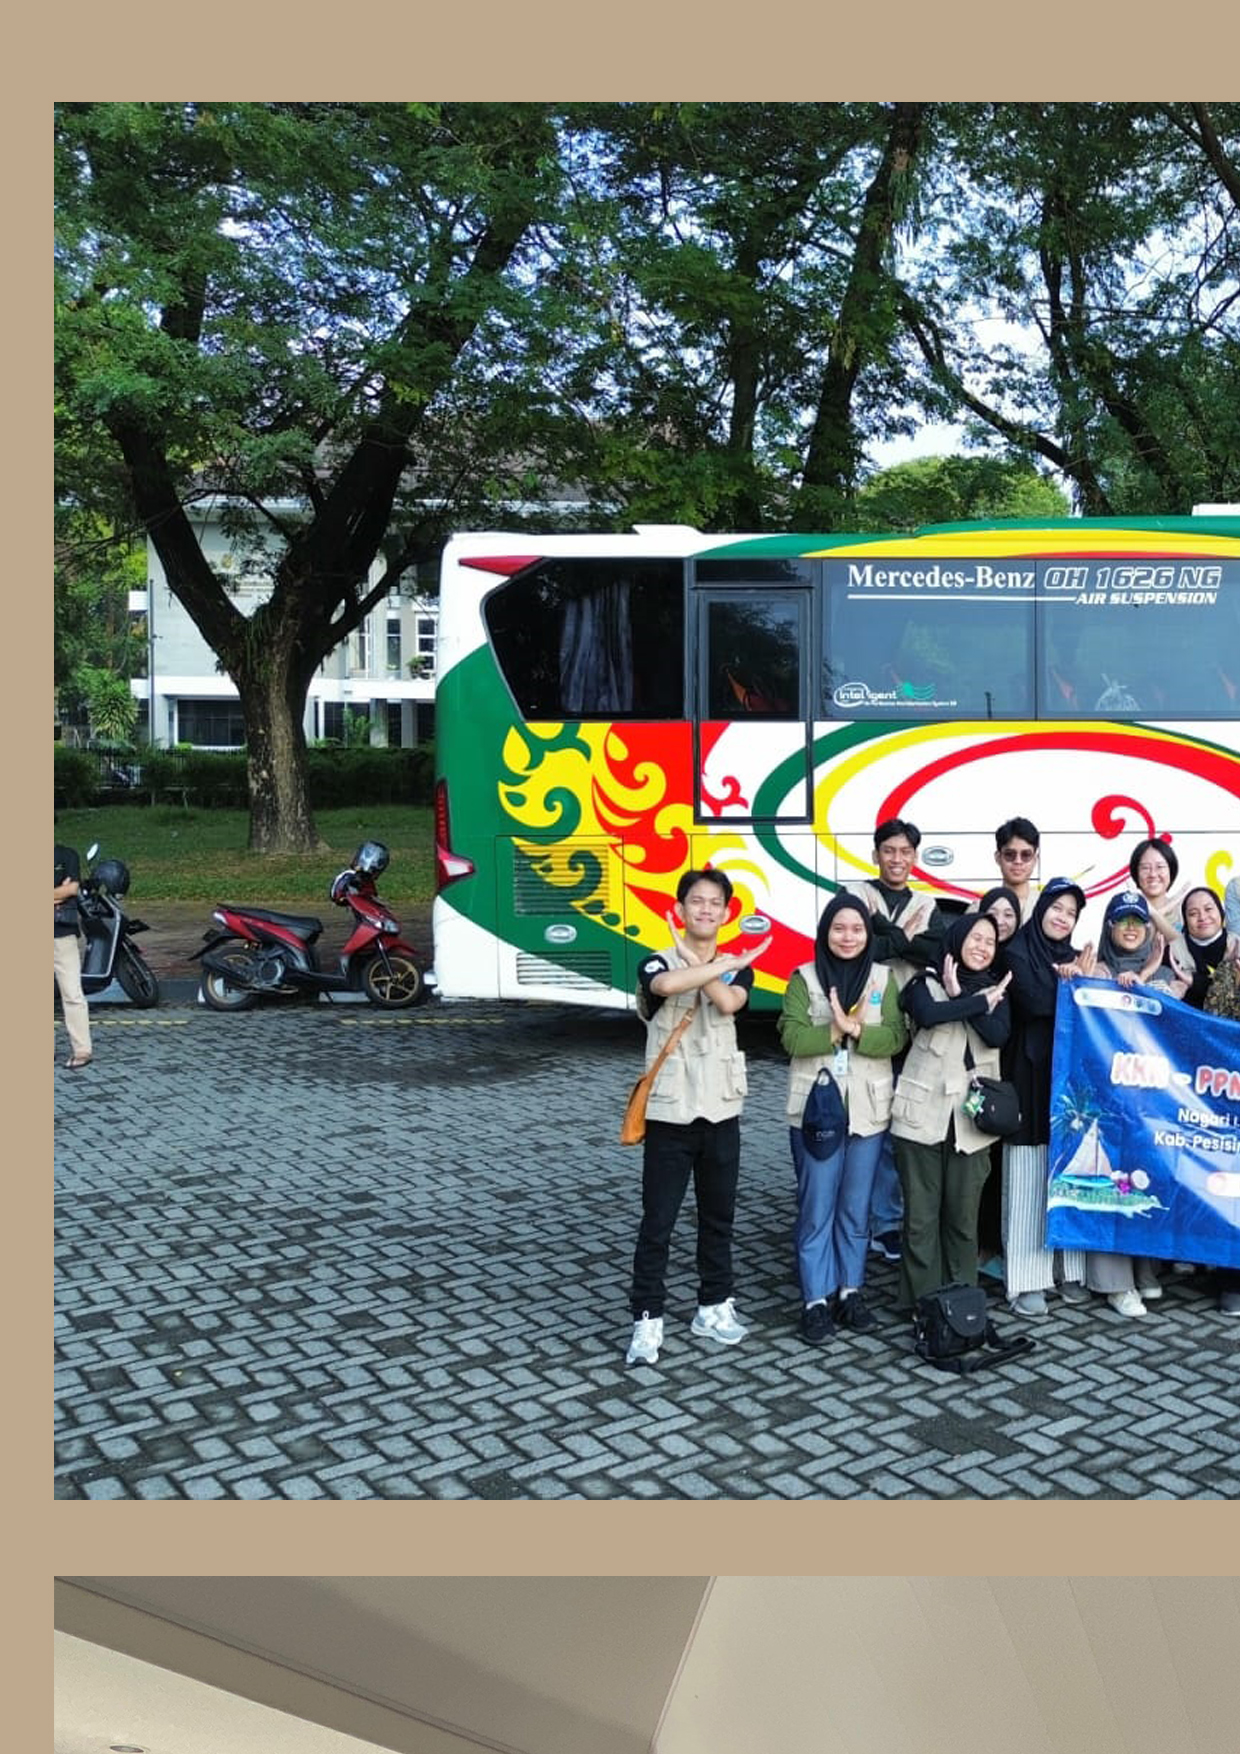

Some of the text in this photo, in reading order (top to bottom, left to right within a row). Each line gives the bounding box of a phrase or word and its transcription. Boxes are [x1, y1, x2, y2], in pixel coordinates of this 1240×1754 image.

[848, 564, 1222, 589] Mercedes-Benz OH 1626 NG
[1075, 592, 1217, 605] AIR SUSPENSION
[1178, 1107, 1230, 1130] Nagari
[1154, 1130, 1190, 1148] Kab.
